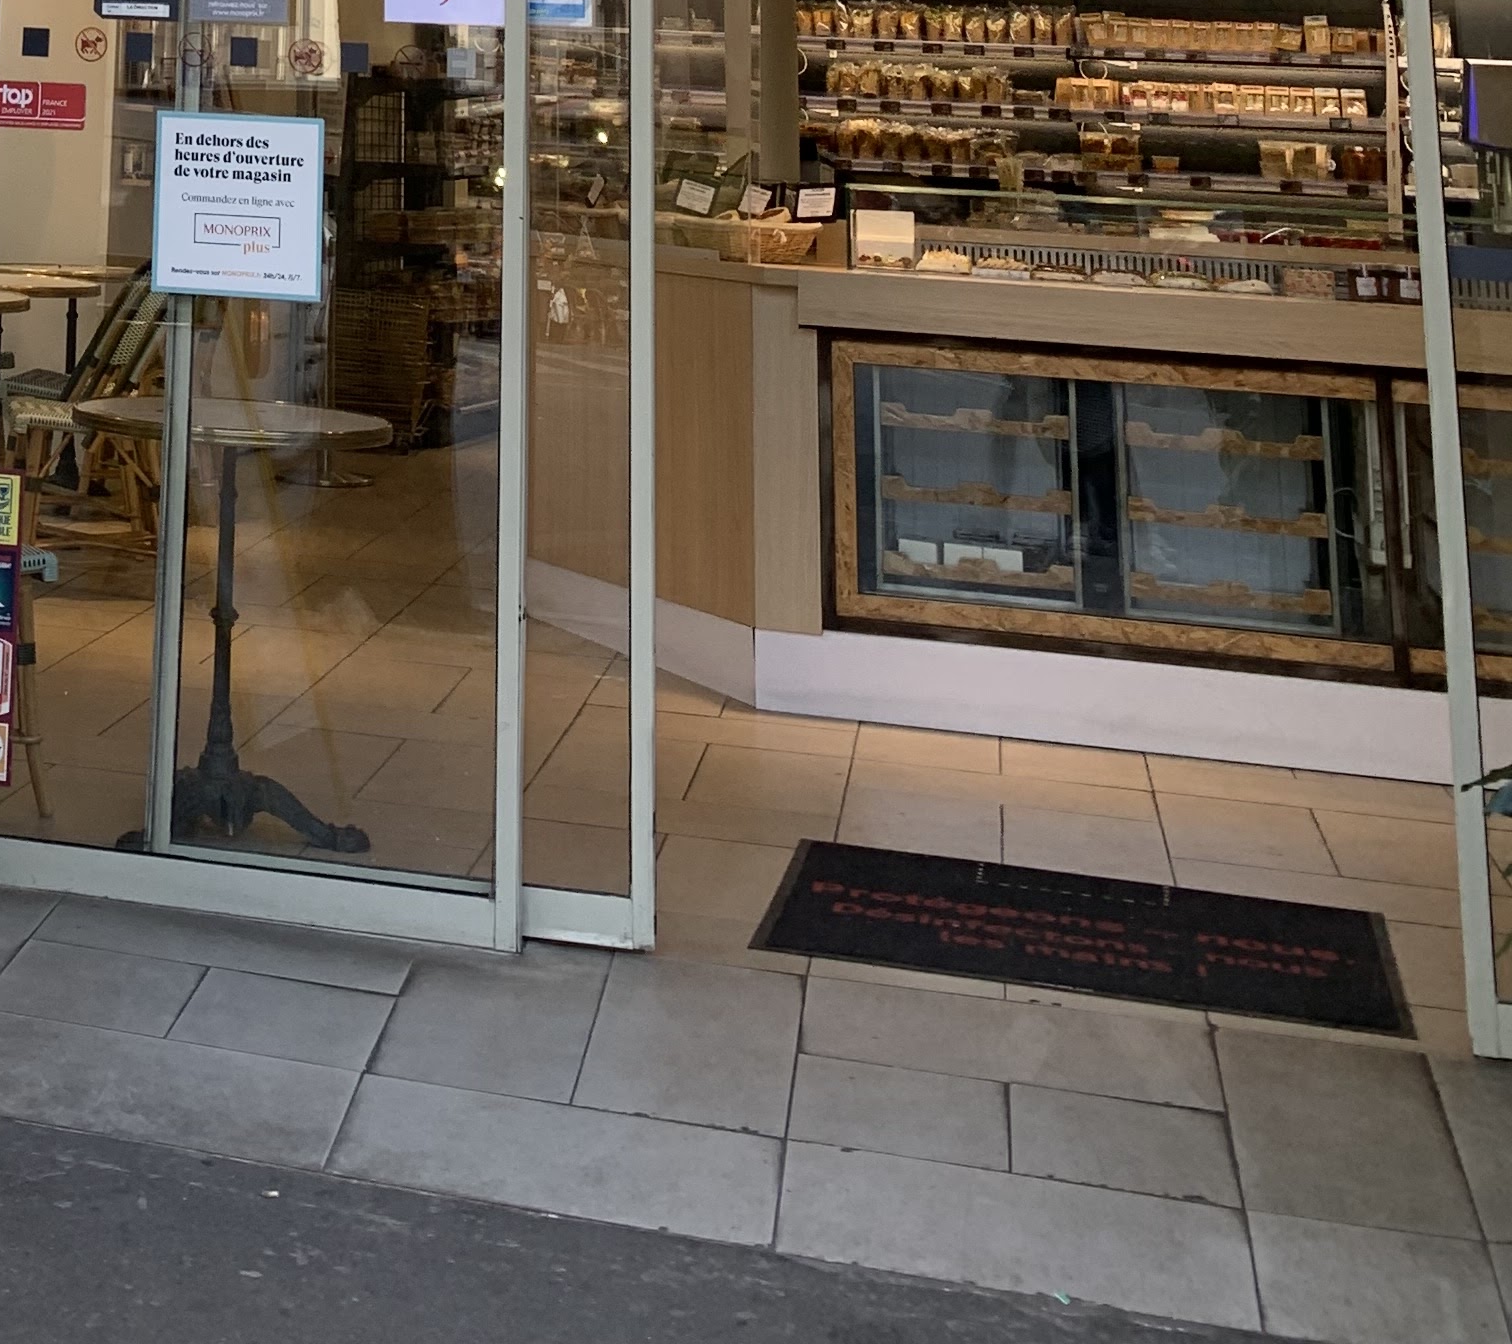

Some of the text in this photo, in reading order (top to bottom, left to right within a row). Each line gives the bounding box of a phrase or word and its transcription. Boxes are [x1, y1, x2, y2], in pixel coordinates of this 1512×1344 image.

[0, 84, 34, 108] top
[42, 99, 68, 107] FRANCE
[175, 132, 270, 149] En dehors des
[174, 148, 304, 168] heures d'ouverture
[174, 164, 292, 184] de votre magasin
[181, 192, 295, 209] Commandez en ligne avec
[203, 223, 271, 238] MONOPRIX
[243, 240, 271, 255] plus
[171, 267, 210, 275] Rendez-vous
[939, 930, 1173, 972] les mains
